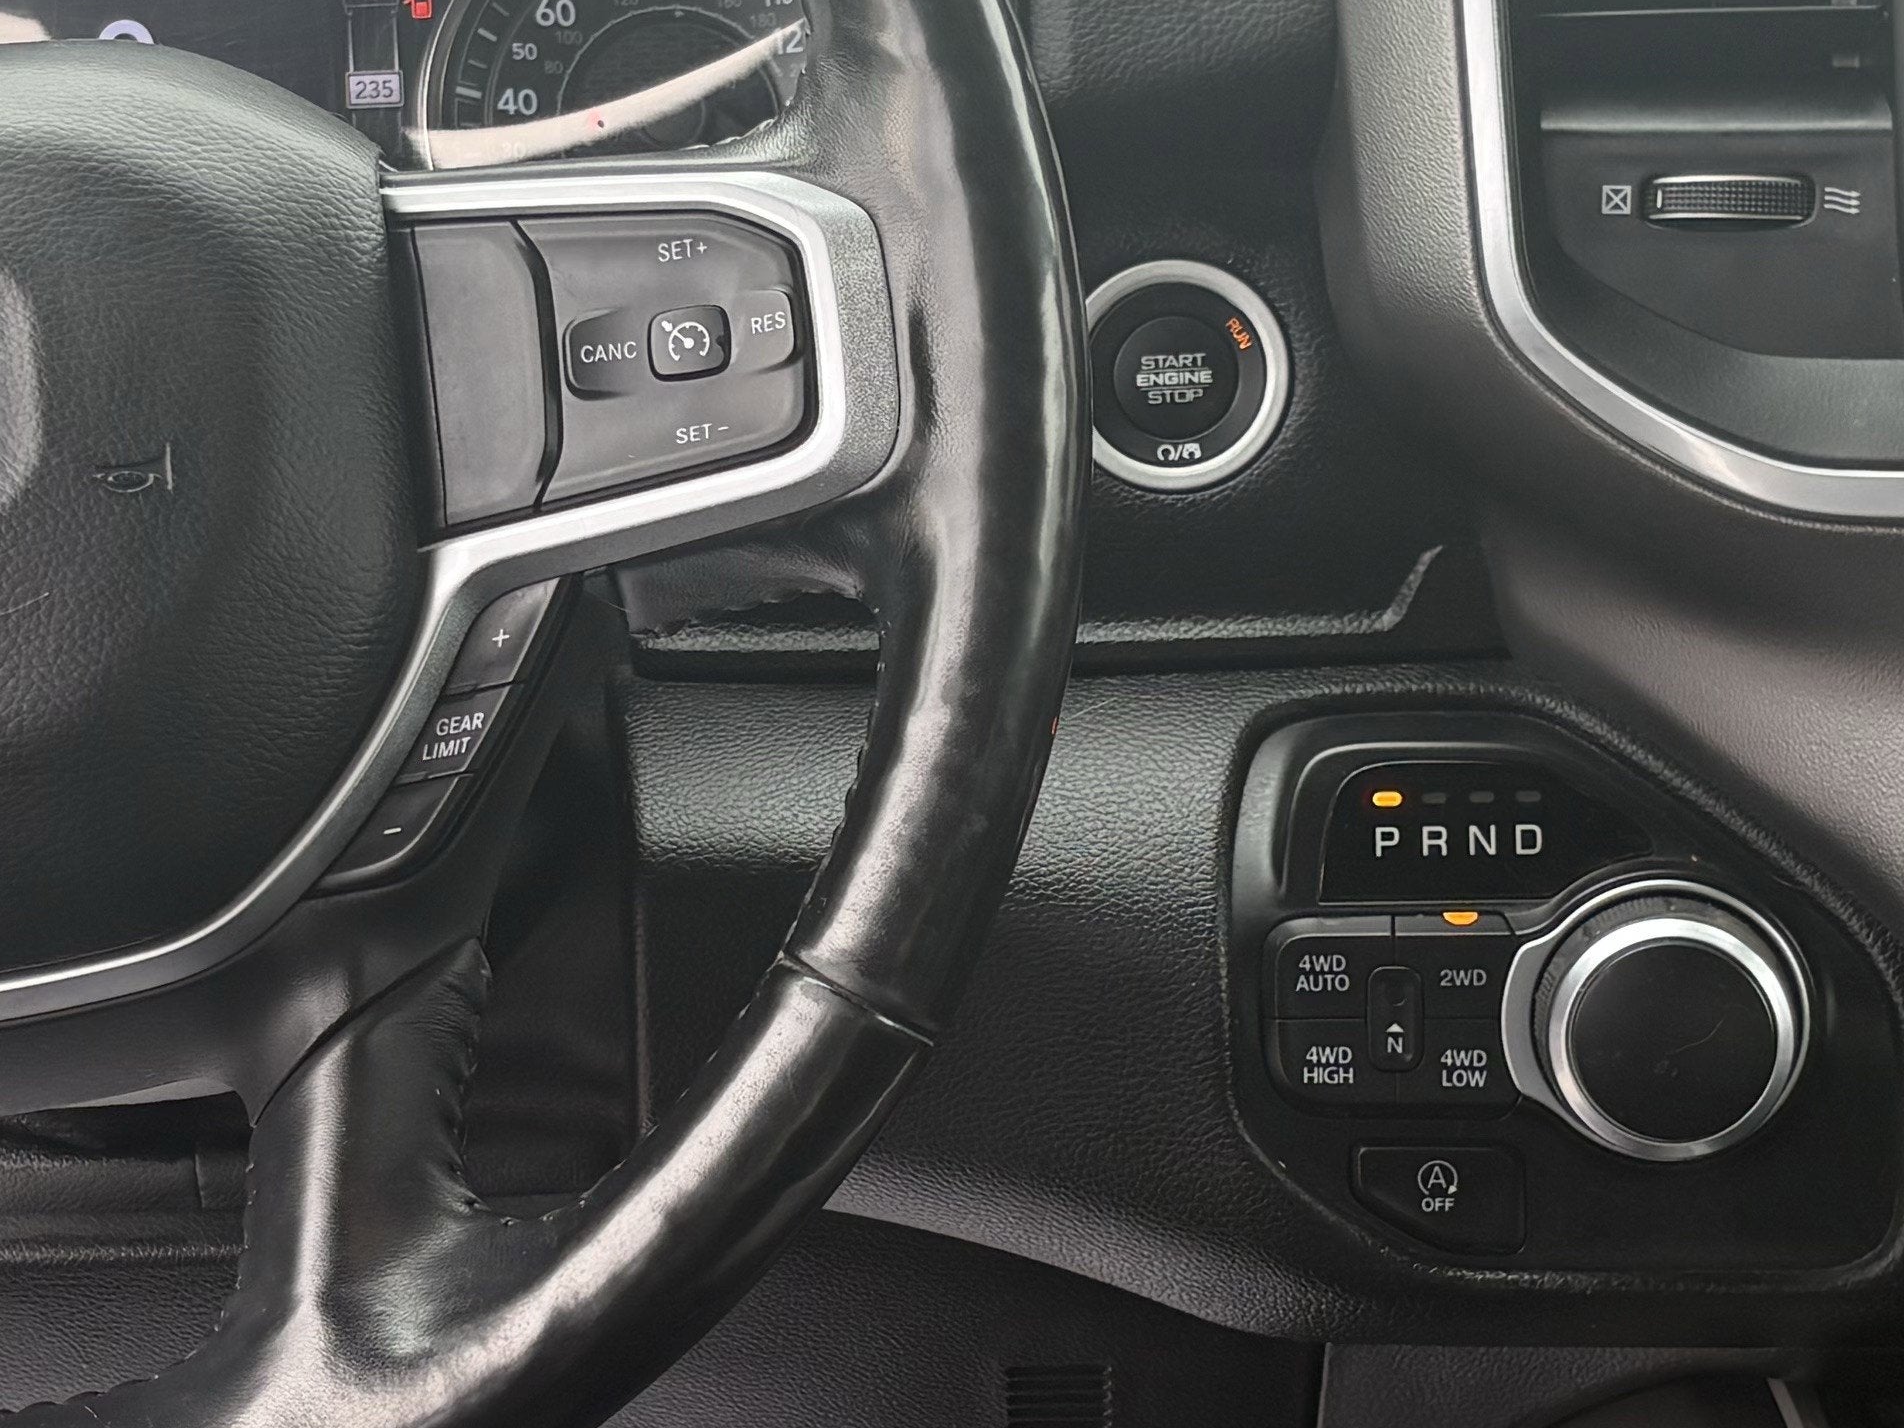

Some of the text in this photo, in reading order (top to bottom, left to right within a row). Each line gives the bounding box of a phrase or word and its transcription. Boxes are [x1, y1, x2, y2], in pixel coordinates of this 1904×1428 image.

[536, 0, 575, 26] 60
[511, 43, 537, 61] 50
[355, 81, 394, 100] 235
[498, 88, 537, 115] 40
[751, 313, 786, 334] RES
[1227, 318, 1252, 350] RUN
[581, 342, 637, 363] CANC
[1141, 353, 1205, 370] START
[1136, 371, 1212, 387] ENGINE
[1148, 389, 1203, 404] STOP
[437, 713, 484, 736] GEAR
[423, 738, 469, 761] LIMIT
[1375, 824, 1543, 856] P R N D
[1299, 955, 1346, 972] 4WD
[1296, 973, 1349, 992] AUTO
[1440, 970, 1486, 987] 2WD
[1387, 1037, 1403, 1054] N
[1306, 1046, 1352, 1065] 4WD
[1440, 1049, 1487, 1067] 4WD
[1303, 1066, 1354, 1084] HIGH
[1441, 1069, 1487, 1088] LOW
[1422, 1197, 1455, 1212] OFF
